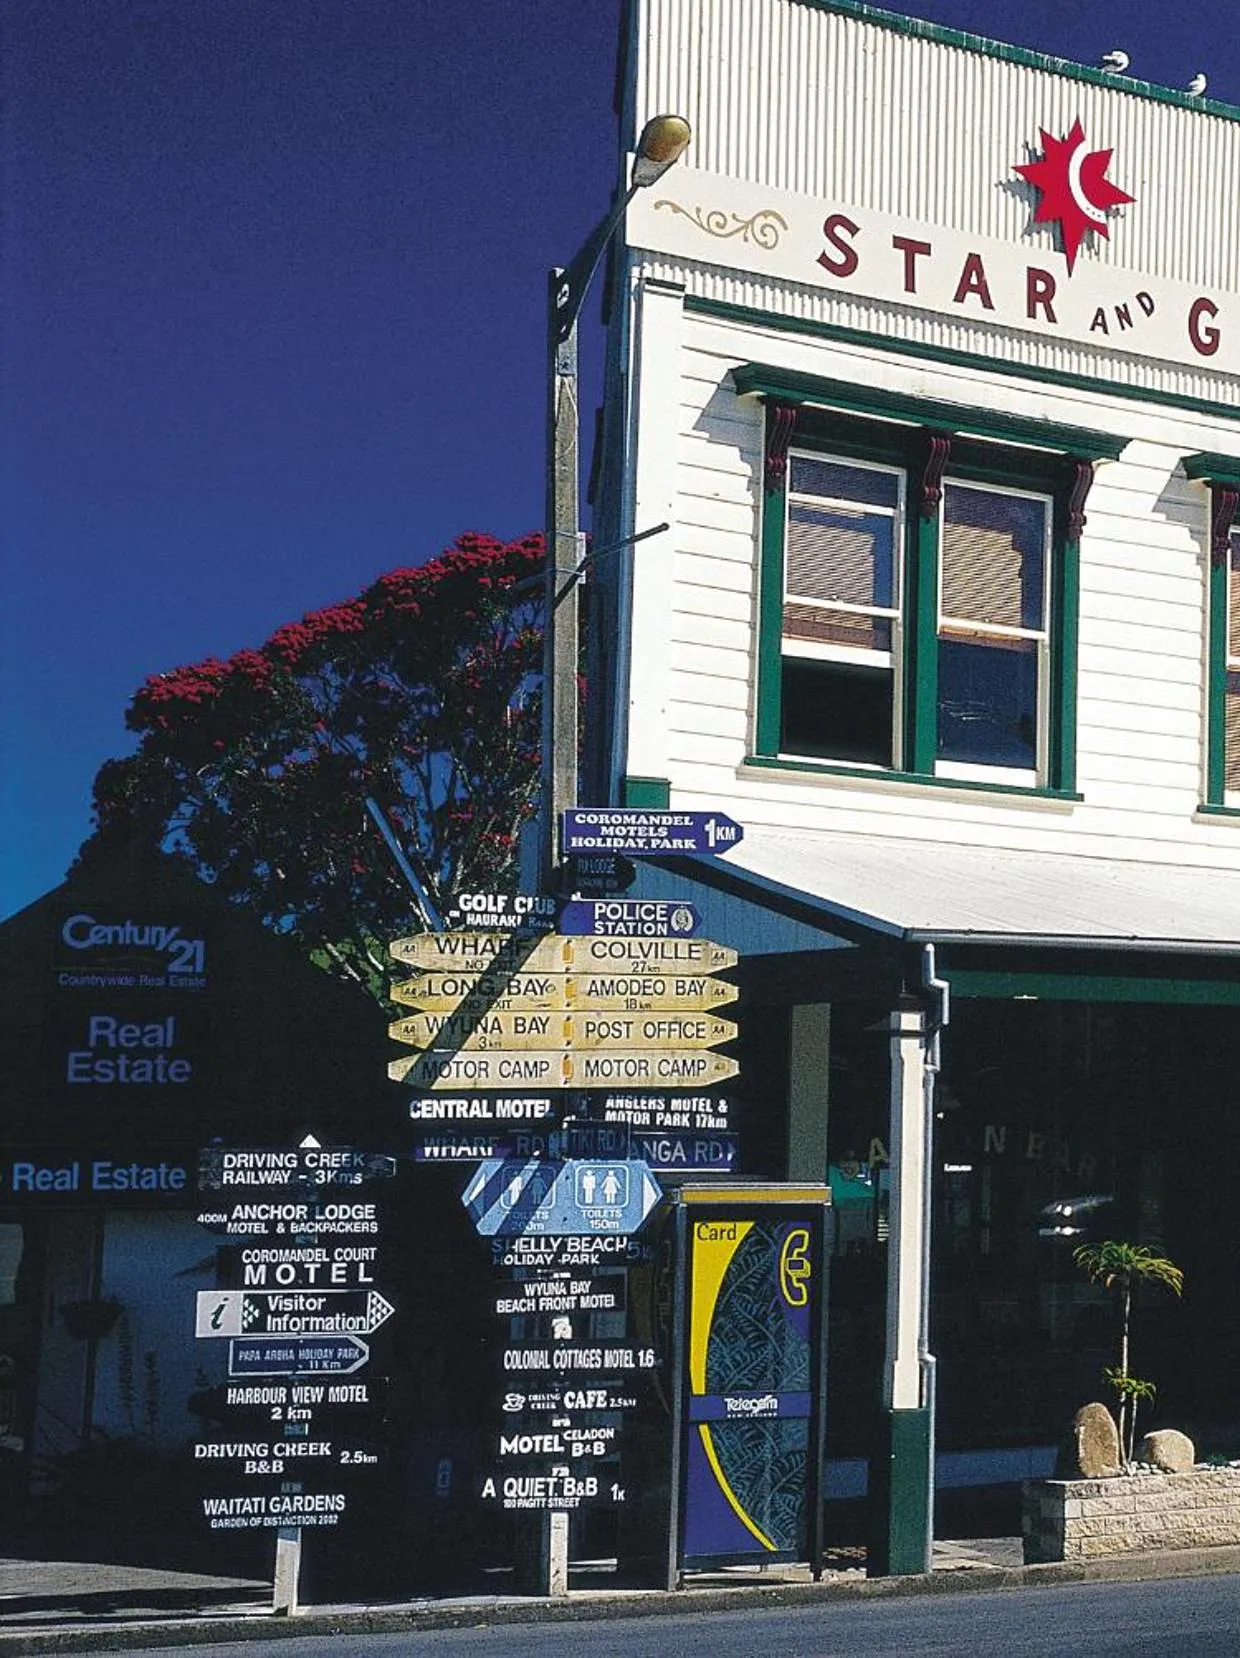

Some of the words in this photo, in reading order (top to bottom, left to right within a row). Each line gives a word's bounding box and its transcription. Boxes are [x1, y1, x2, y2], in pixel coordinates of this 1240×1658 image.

[816, 214, 1058, 324] STAR
[1090, 291, 1155, 335] AND
[575, 814, 694, 826] COROMANDEL
[600, 826, 668, 838] MOTELS
[651, 838, 697, 850] PARK
[459, 893, 508, 913] GOLF
[514, 896, 556, 915] CLUB
[594, 903, 669, 921] POLICE
[62, 913, 183, 951] Century
[594, 921, 668, 936] STATION
[168, 938, 206, 973] 21
[591, 941, 702, 960] COLVILLE
[465, 960, 484, 971] NO
[427, 978, 495, 997] LONG
[507, 978, 551, 997] BAY
[588, 980, 666, 997] AMODEO
[675, 980, 707, 996] BAY
[88, 1016, 176, 1048] Real
[425, 1016, 503, 1034] WYUNA
[514, 1017, 550, 1034] BAY
[585, 1021, 634, 1039] POST
[643, 1021, 707, 1039] OFFICE
[67, 1052, 192, 1084] Estate
[422, 1060, 489, 1079] MOTOR
[499, 1060, 550, 1079] CAMP
[585, 1059, 649, 1078] MOTOR
[657, 1059, 707, 1078] CAMP
[410, 1099, 493, 1118] CENTRAL
[495, 1099, 554, 1118] MOTEL
[605, 1095, 665, 1111] ANGLERS
[671, 1098, 713, 1112] MOTEL
[604, 1110, 650, 1126] MOTOR
[656, 1114, 690, 1127] PARK
[629, 1140, 686, 1162] ANGA
[694, 1140, 723, 1162] RD
[223, 1153, 298, 1168] DRIVING
[305, 1153, 364, 1168] CREEK
[13, 1162, 80, 1191] Real
[92, 1162, 186, 1190] Estate
[222, 1170, 291, 1185] RAILWAY
[231, 1204, 308, 1220] ANCHOR
[315, 1204, 376, 1220] LODGE
[581, 1209, 623, 1218] TOILETS
[226, 1223, 268, 1234] MOTEL
[276, 1222, 285, 1234] &
[290, 1222, 378, 1234] BACKPACKERS
[697, 1223, 737, 1241] Card
[491, 1236, 563, 1253] SHELLY
[567, 1236, 628, 1252] BEACH
[242, 1249, 329, 1263] COROMANDEL
[334, 1247, 377, 1261] COURT
[492, 1253, 555, 1266] HOLIDAY
[561, 1253, 601, 1266] PARK
[244, 1263, 373, 1285] MOTEL
[524, 1281, 566, 1297] WYUNA
[570, 1280, 593, 1294] BAY
[268, 1296, 326, 1311] Visitor
[496, 1298, 535, 1314] BEACH
[538, 1296, 578, 1312] FRONT
[267, 1314, 366, 1331] Information
[337, 1348, 359, 1359] PARK
[552, 1349, 602, 1370] COTTAGES
[603, 1349, 636, 1369] MOTEL
[227, 1387, 287, 1404] HARBOUR
[292, 1386, 325, 1403] VIEW
[328, 1385, 369, 1402] MOTEL
[563, 1390, 608, 1409] CAFE
[271, 1407, 282, 1420] 2
[287, 1406, 312, 1420] km
[563, 1428, 614, 1440] CELADON
[195, 1443, 268, 1458] DRIVING
[273, 1443, 331, 1457] CREEK
[500, 1434, 564, 1455] MOTEL
[572, 1442, 606, 1457] B&B
[245, 1460, 284, 1473] B&B
[481, 1478, 496, 1498] A
[563, 1477, 598, 1497] B&B
[203, 1497, 265, 1515] WAITATI
[269, 1495, 345, 1513] GARDENS
[548, 1497, 580, 1508] STREET
[249, 1517, 262, 1527] OF
